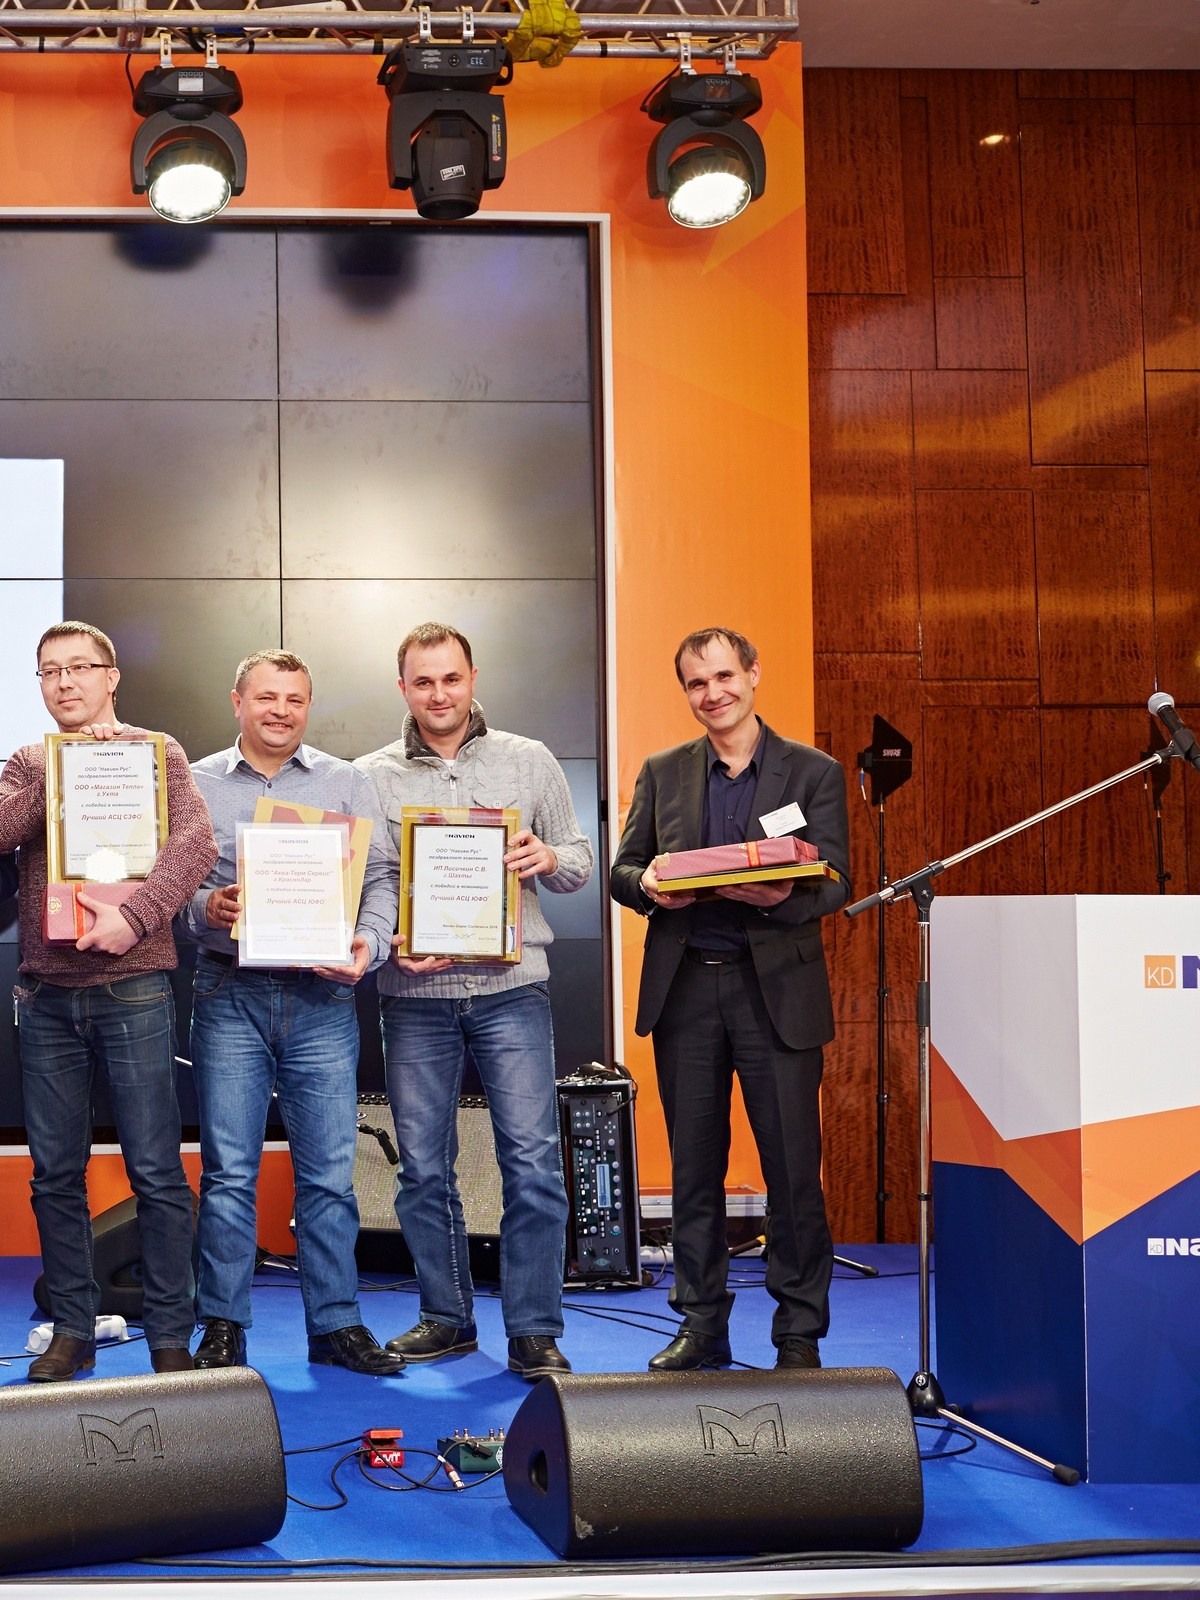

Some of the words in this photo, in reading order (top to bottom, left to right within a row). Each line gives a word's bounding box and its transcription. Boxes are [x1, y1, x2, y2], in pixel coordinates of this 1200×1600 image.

[470, 57, 484, 65] 313
[882, 748, 902, 757] SHURE
[1146, 966, 1175, 987] KD
